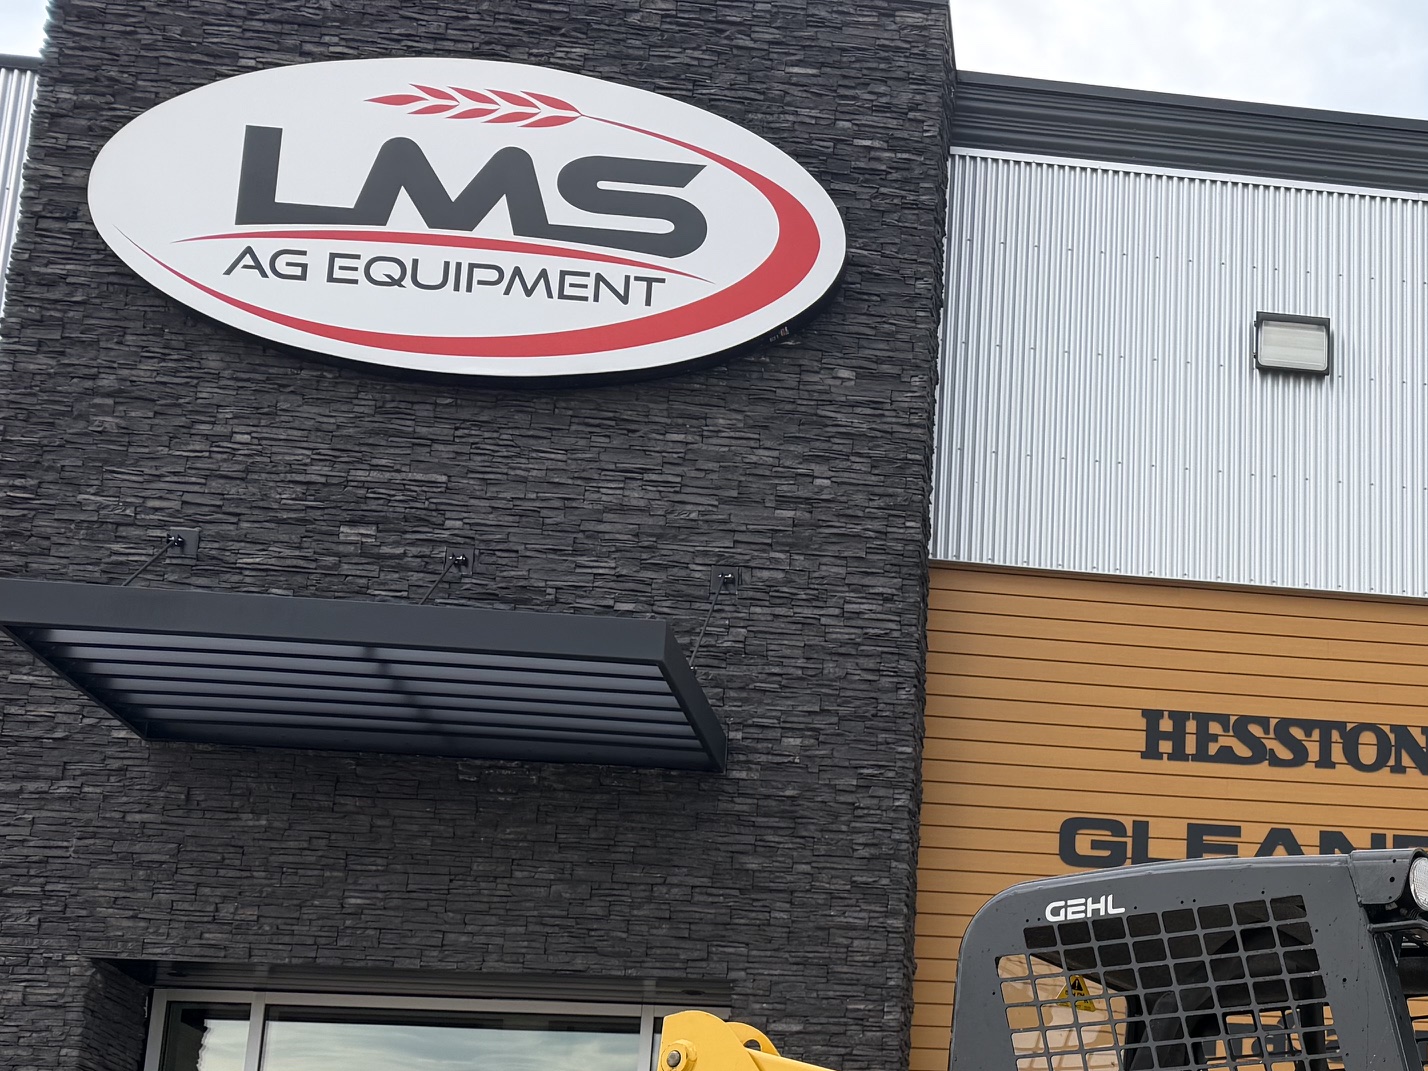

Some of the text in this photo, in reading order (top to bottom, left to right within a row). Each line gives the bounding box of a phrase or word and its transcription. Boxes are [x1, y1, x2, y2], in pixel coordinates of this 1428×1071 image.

[235, 124, 707, 260] LMS
[222, 248, 667, 308] AG EQUIPMENT
[1045, 893, 1126, 922] GEHL
